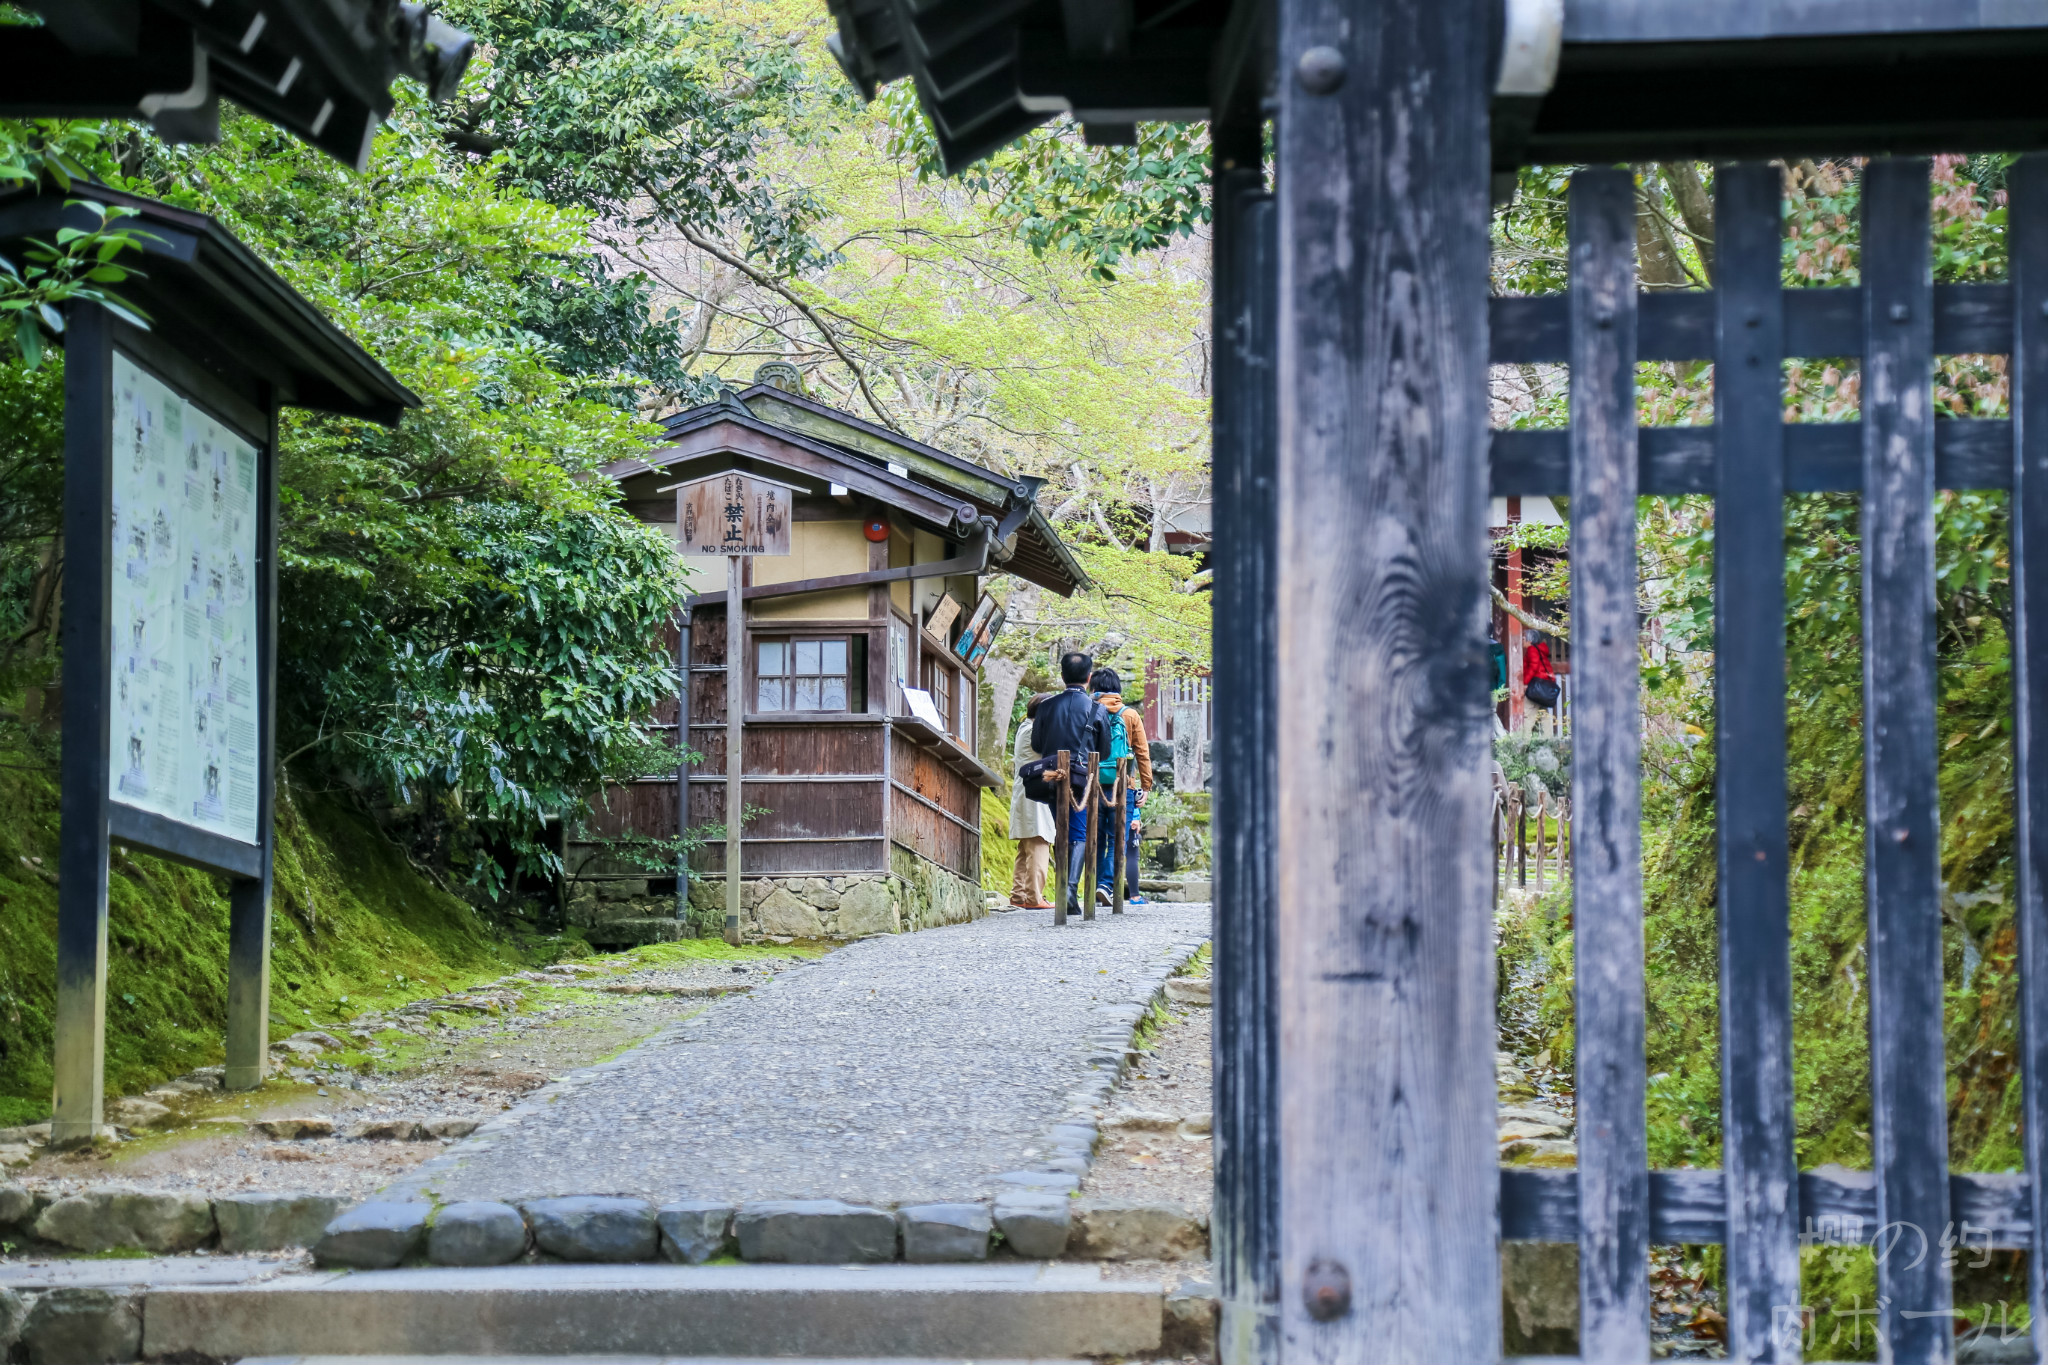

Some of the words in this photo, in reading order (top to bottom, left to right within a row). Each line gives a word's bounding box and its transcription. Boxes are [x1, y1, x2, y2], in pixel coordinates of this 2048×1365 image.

[724, 477, 732, 500] たばこ
[724, 503, 745, 541] 禁止
[766, 490, 775, 534] 境内全
[702, 545, 715, 553] NO
[720, 545, 765, 553] SMOKING
